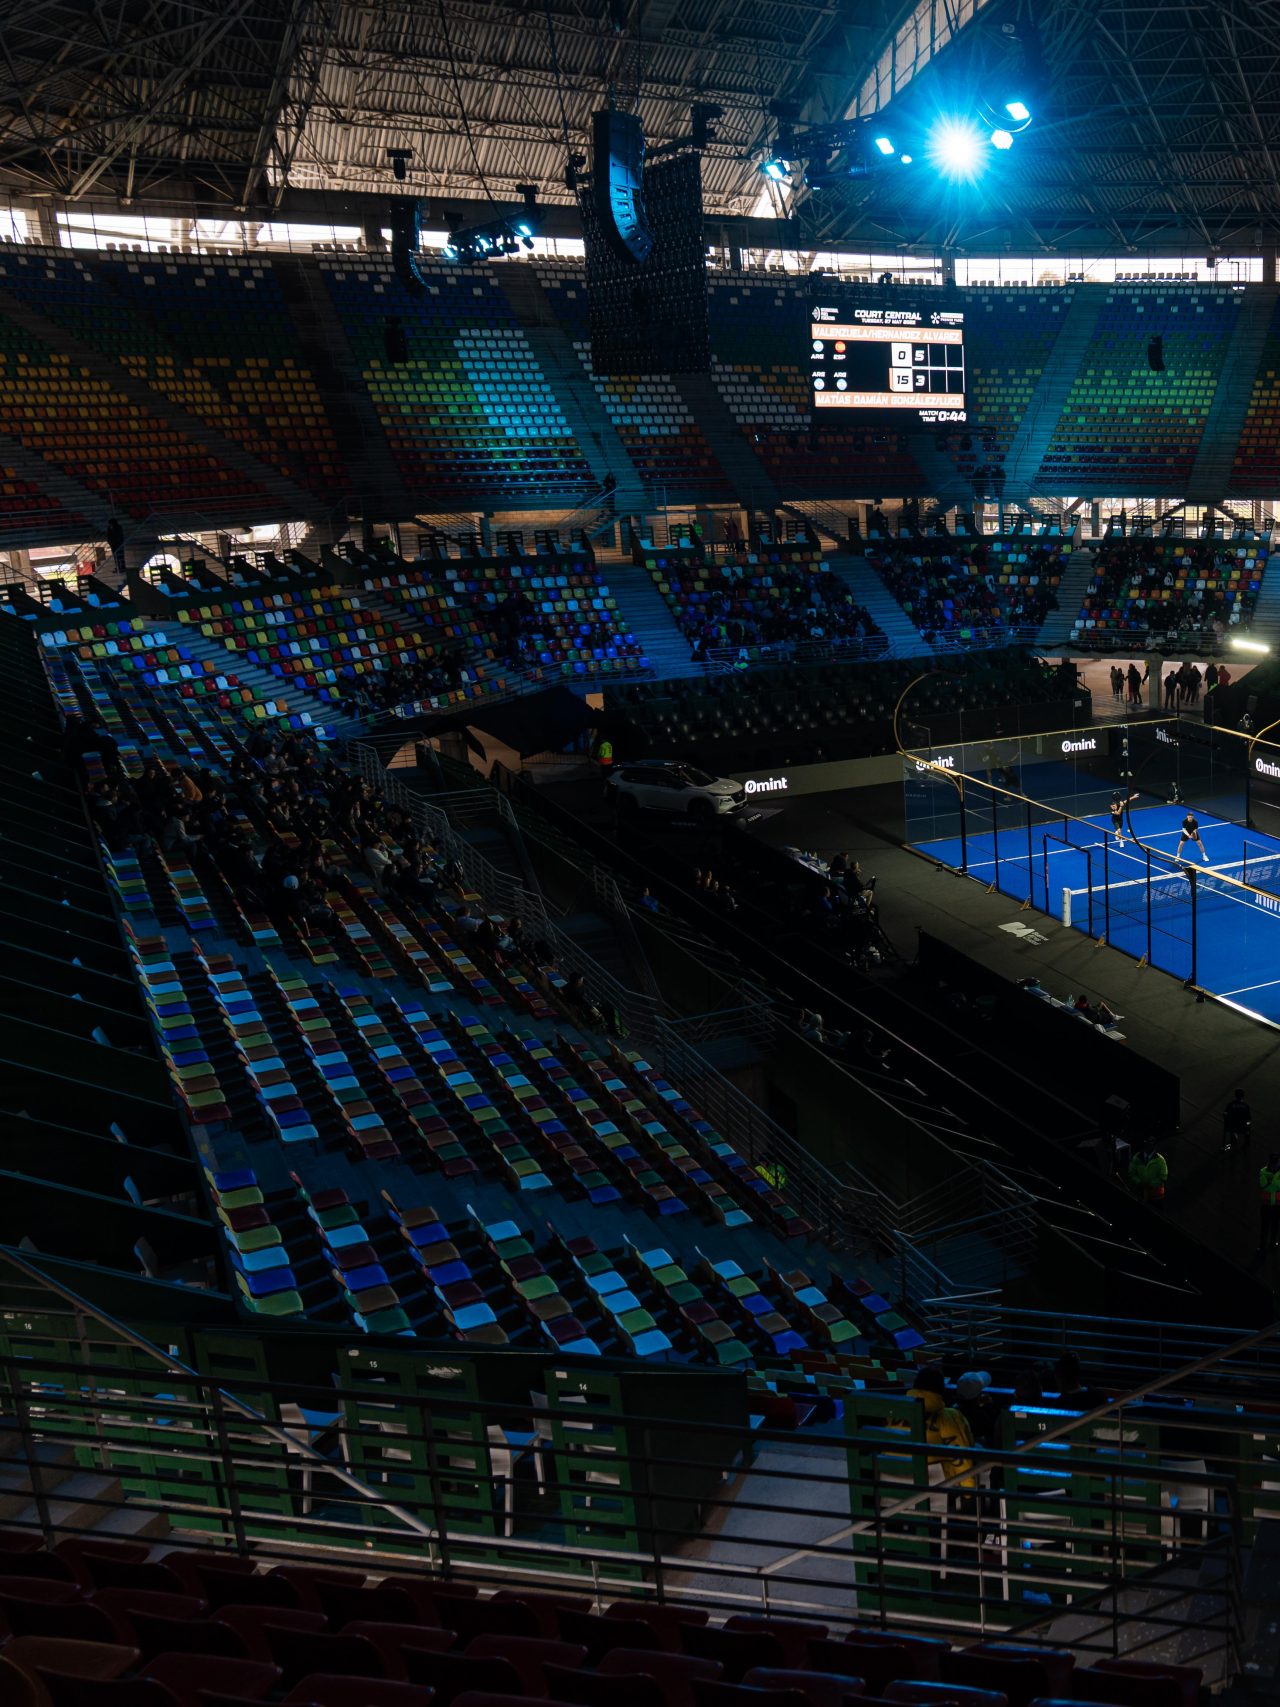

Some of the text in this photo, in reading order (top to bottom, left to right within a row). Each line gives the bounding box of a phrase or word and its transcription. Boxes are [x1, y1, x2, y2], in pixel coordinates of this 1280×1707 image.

[854, 310, 922, 320] COURT CENTRAL
[813, 327, 960, 342] VALENZUELA/HERNANDEZ ALVAREZ
[898, 350, 925, 361] 0 5
[897, 375, 925, 386] 15 3
[816, 392, 850, 405] MATÍAS
[854, 392, 888, 405] DAMIÁN
[938, 411, 966, 421] 0:44
